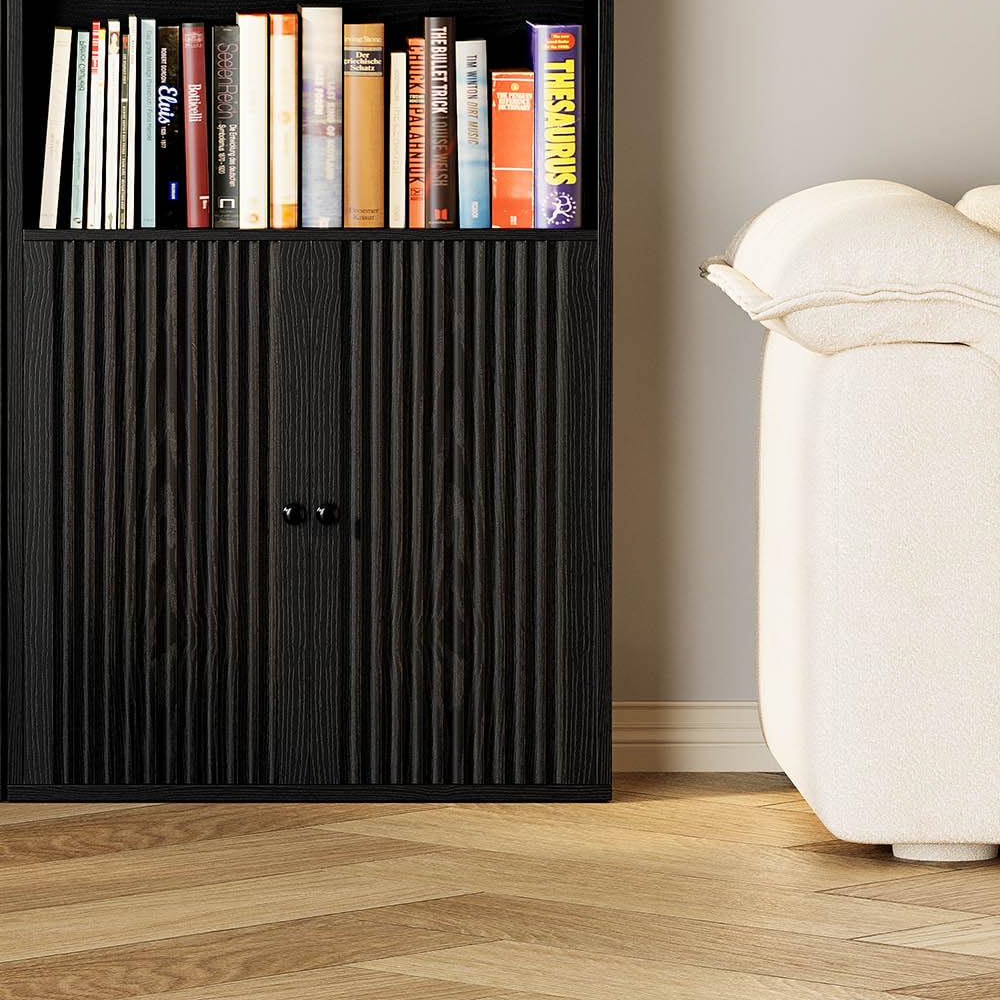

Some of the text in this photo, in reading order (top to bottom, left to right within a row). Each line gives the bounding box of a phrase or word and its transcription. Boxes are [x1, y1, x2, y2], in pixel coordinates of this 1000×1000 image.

[431, 27, 447, 45] THE
[216, 43, 238, 119] SeelenReich
[431, 47, 447, 81] BULLET
[158, 85, 178, 125] Elvis
[188, 84, 202, 122] Botticelli
[409, 45, 424, 184] CHUCK PALAHNIUK
[431, 85, 447, 114] TRICK
[467, 55, 479, 145] TIM WINTON DIRT MUSIC
[432, 116, 447, 150] LOUISE
[543, 59, 576, 185] THESAURUS
